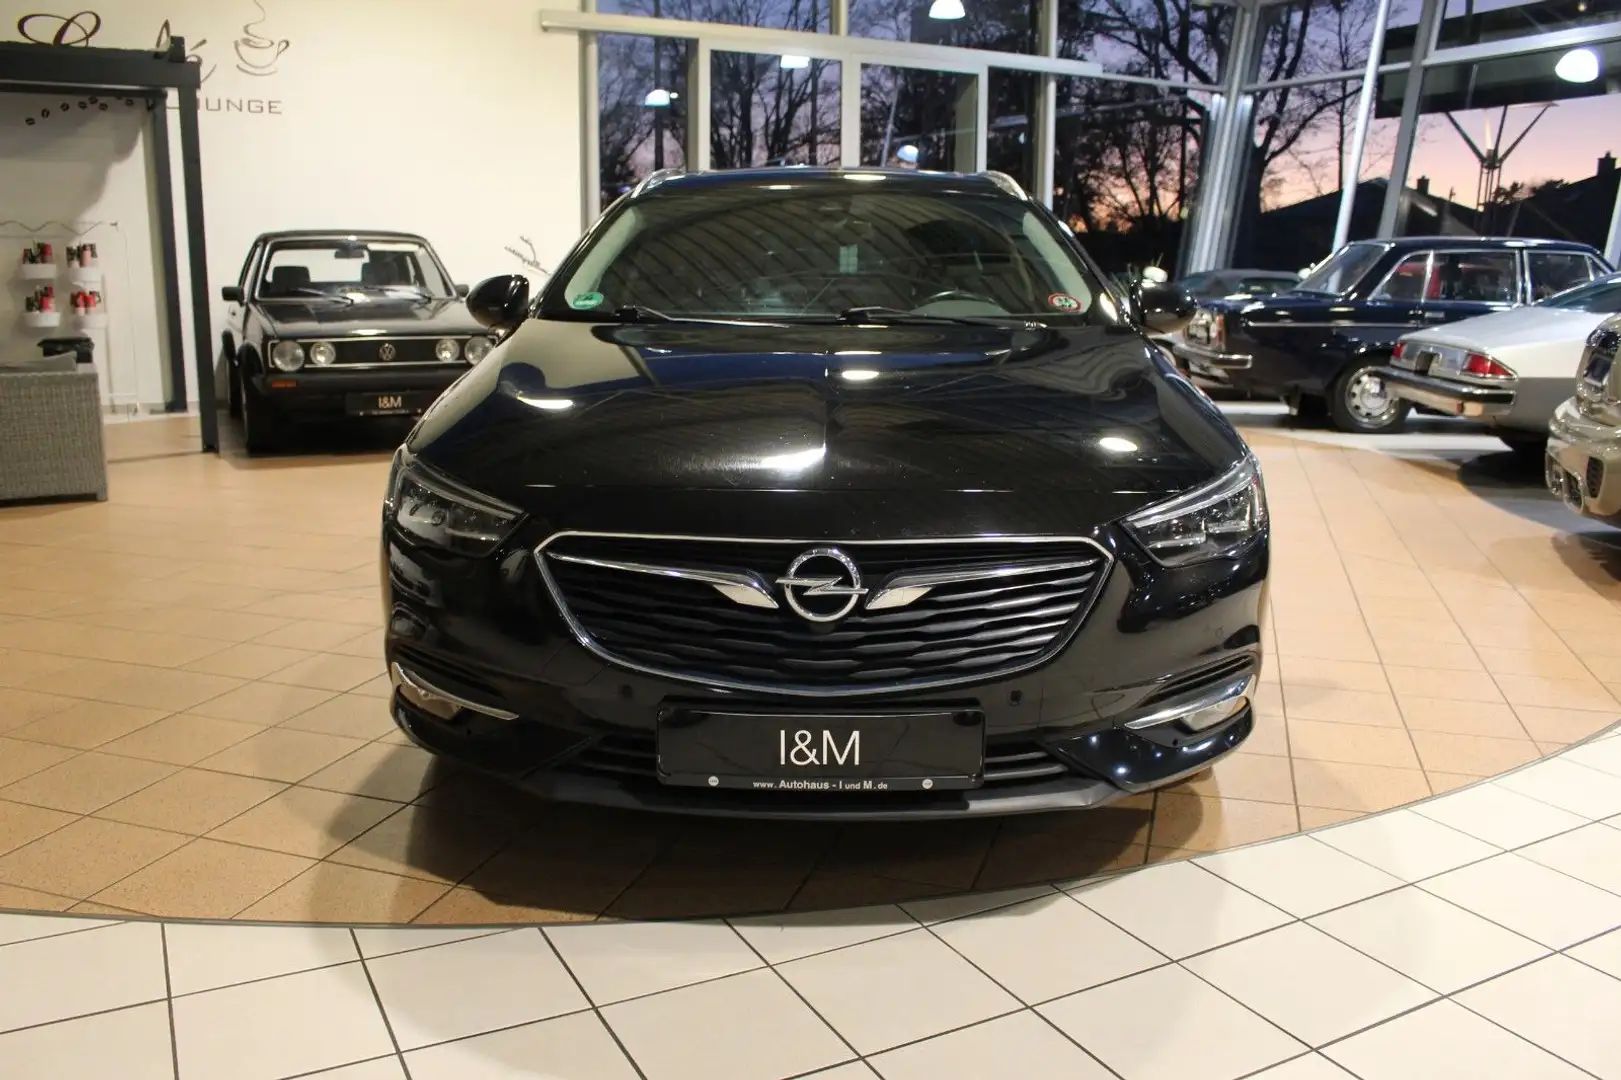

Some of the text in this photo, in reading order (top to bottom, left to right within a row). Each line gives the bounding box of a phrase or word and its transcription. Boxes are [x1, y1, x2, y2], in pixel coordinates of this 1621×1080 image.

[166, 97, 282, 114] UNGE
[378, 395, 402, 408] I&M
[779, 729, 860, 766] I&M
[845, 781, 861, 790] und
